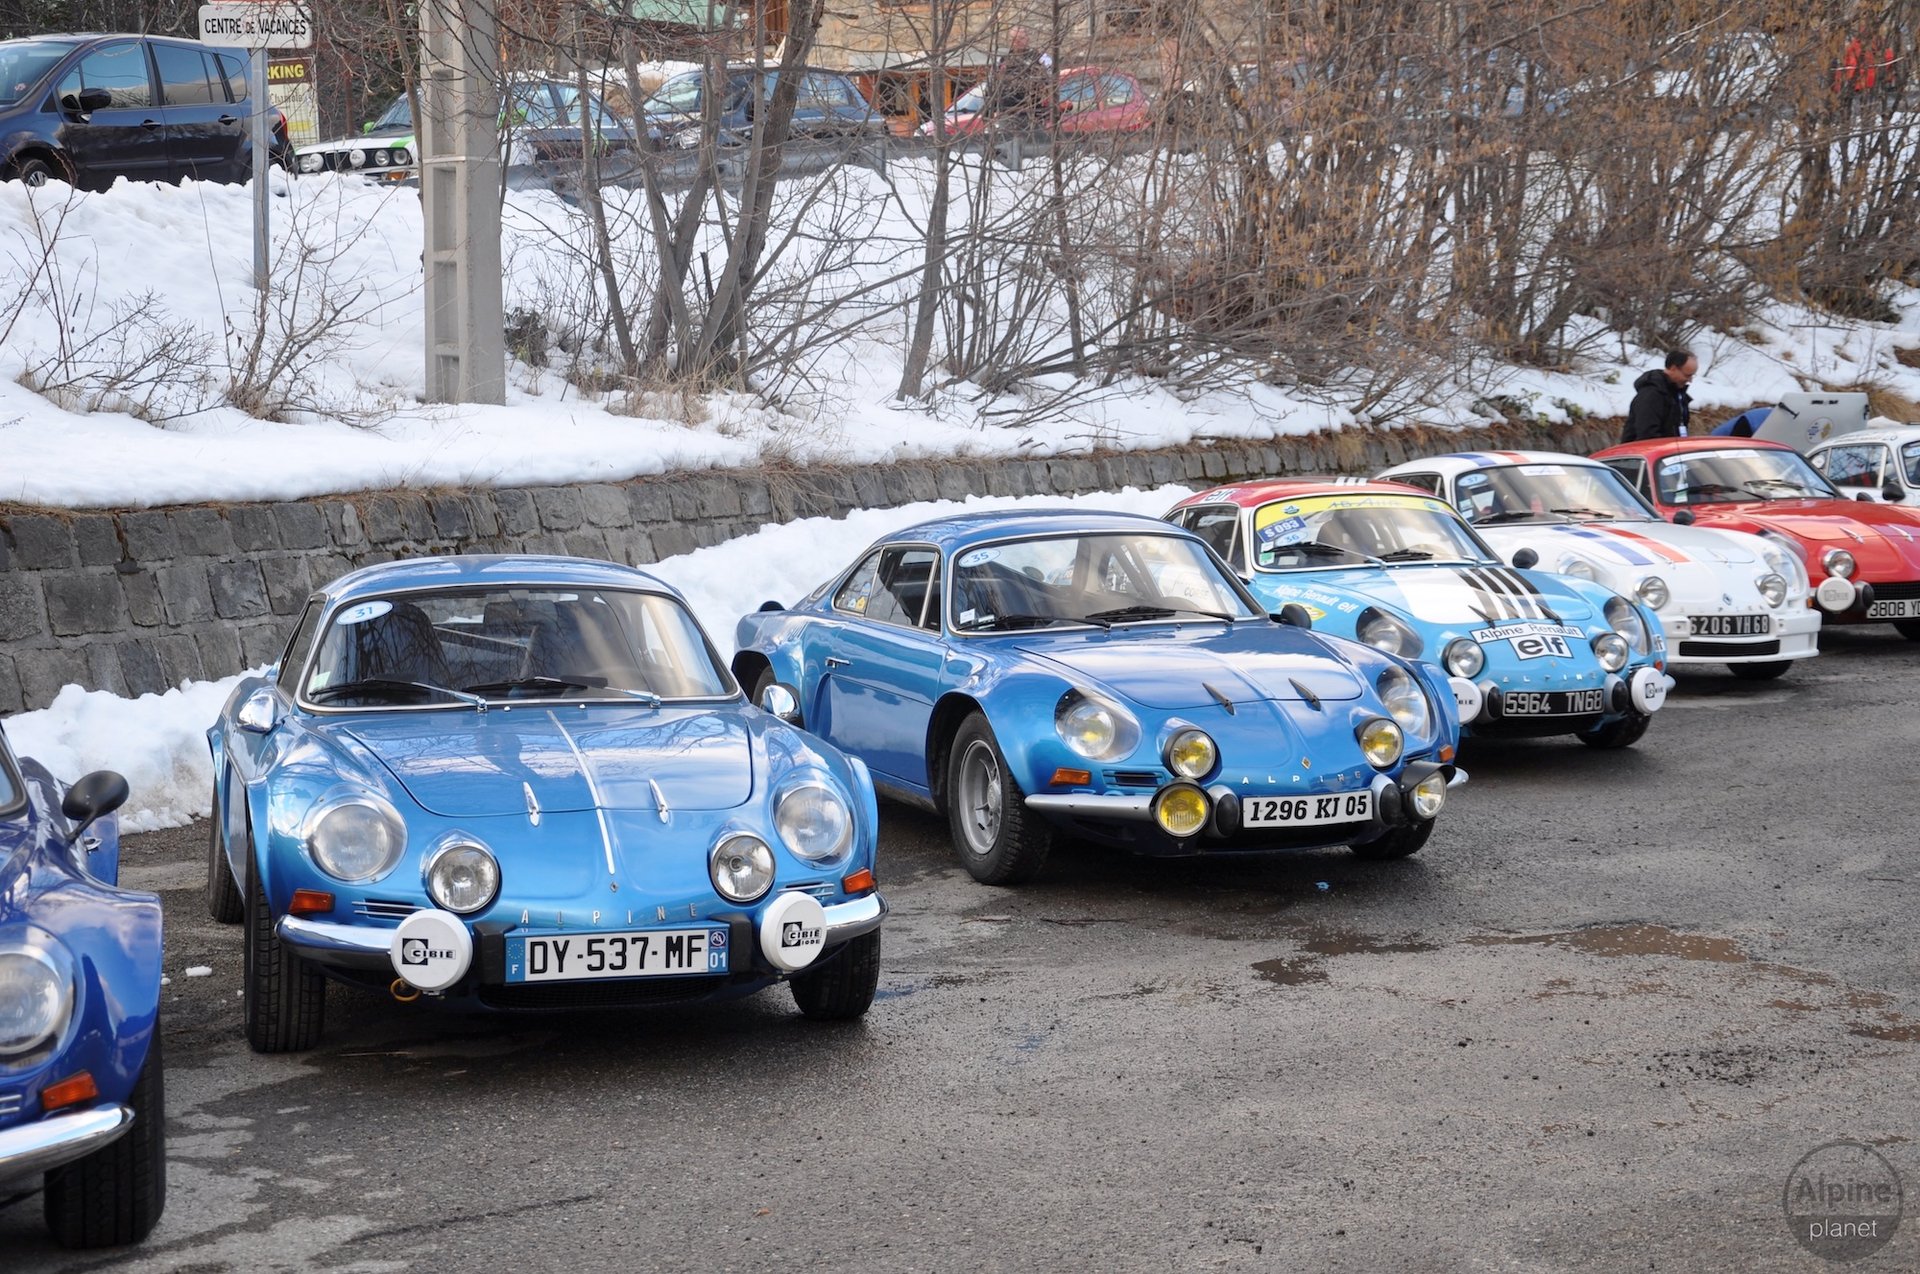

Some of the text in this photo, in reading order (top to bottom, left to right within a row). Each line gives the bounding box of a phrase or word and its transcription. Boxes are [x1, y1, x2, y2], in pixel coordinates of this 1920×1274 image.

[204, 18, 242, 34] CENTRE
[259, 18, 307, 35] VACANCES
[1264, 519, 1300, 538] S 093
[970, 551, 989, 563] 35
[354, 606, 373, 619] 31
[1337, 601, 1360, 614] elf
[1869, 601, 1920, 617] 3808 Y
[1480, 623, 1580, 641] Alpine Renault
[1517, 635, 1565, 656] elf
[1505, 693, 1552, 714] 5964
[1241, 770, 1361, 785] ALPINE
[1250, 795, 1368, 822] 1296 KJ 05
[520, 902, 698, 926] ALPINE
[529, 934, 706, 975] DY-537-MF
[709, 951, 727, 969] 01
[511, 963, 520, 975] F
